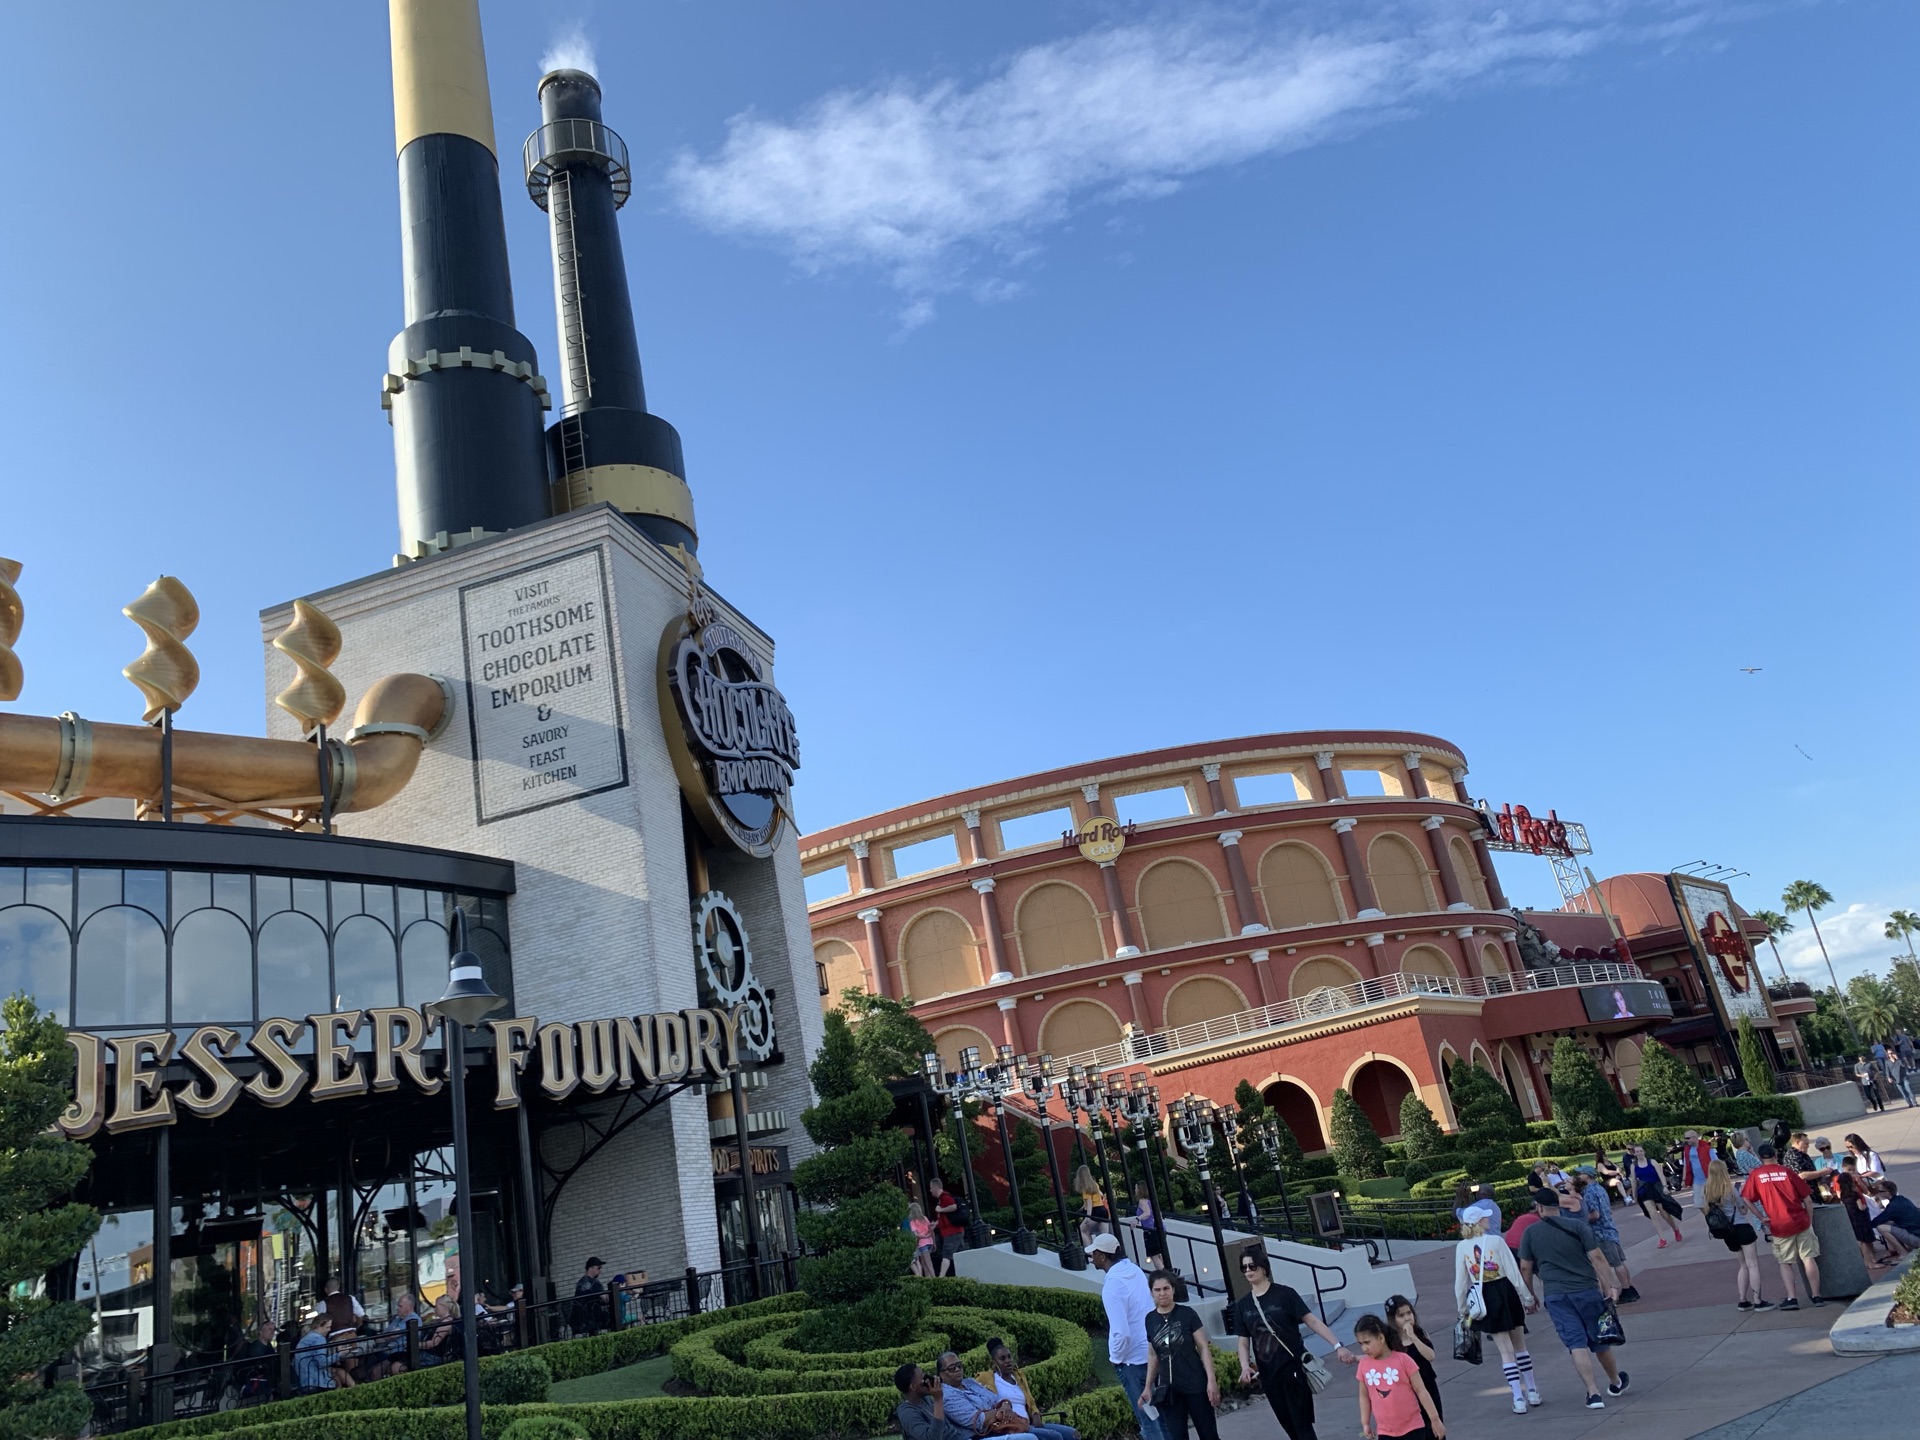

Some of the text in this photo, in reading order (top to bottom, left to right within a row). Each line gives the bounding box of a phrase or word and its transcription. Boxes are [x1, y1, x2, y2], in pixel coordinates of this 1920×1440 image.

[514, 581, 549, 601] VISIT
[508, 595, 561, 617] THE FAMOUS
[478, 602, 595, 652] TOOTHSOME
[483, 633, 596, 681] CHOCOLATE
[705, 625, 762, 676] TOOTHSOME
[490, 664, 593, 709] EMPORIUM
[537, 703, 553, 721] &
[676, 638, 800, 764] CHOCOLATE
[522, 725, 569, 748] SAVORY
[529, 747, 566, 768] FEAST
[522, 764, 577, 791] KITCHEN
[715, 759, 786, 795] EMPORIUM
[1061, 818, 1137, 847] Hard Rock
[1090, 844, 1117, 856] CAFE
[488, 1003, 748, 1110] FOUNDRY
[748, 1148, 780, 1174] PIRITS
